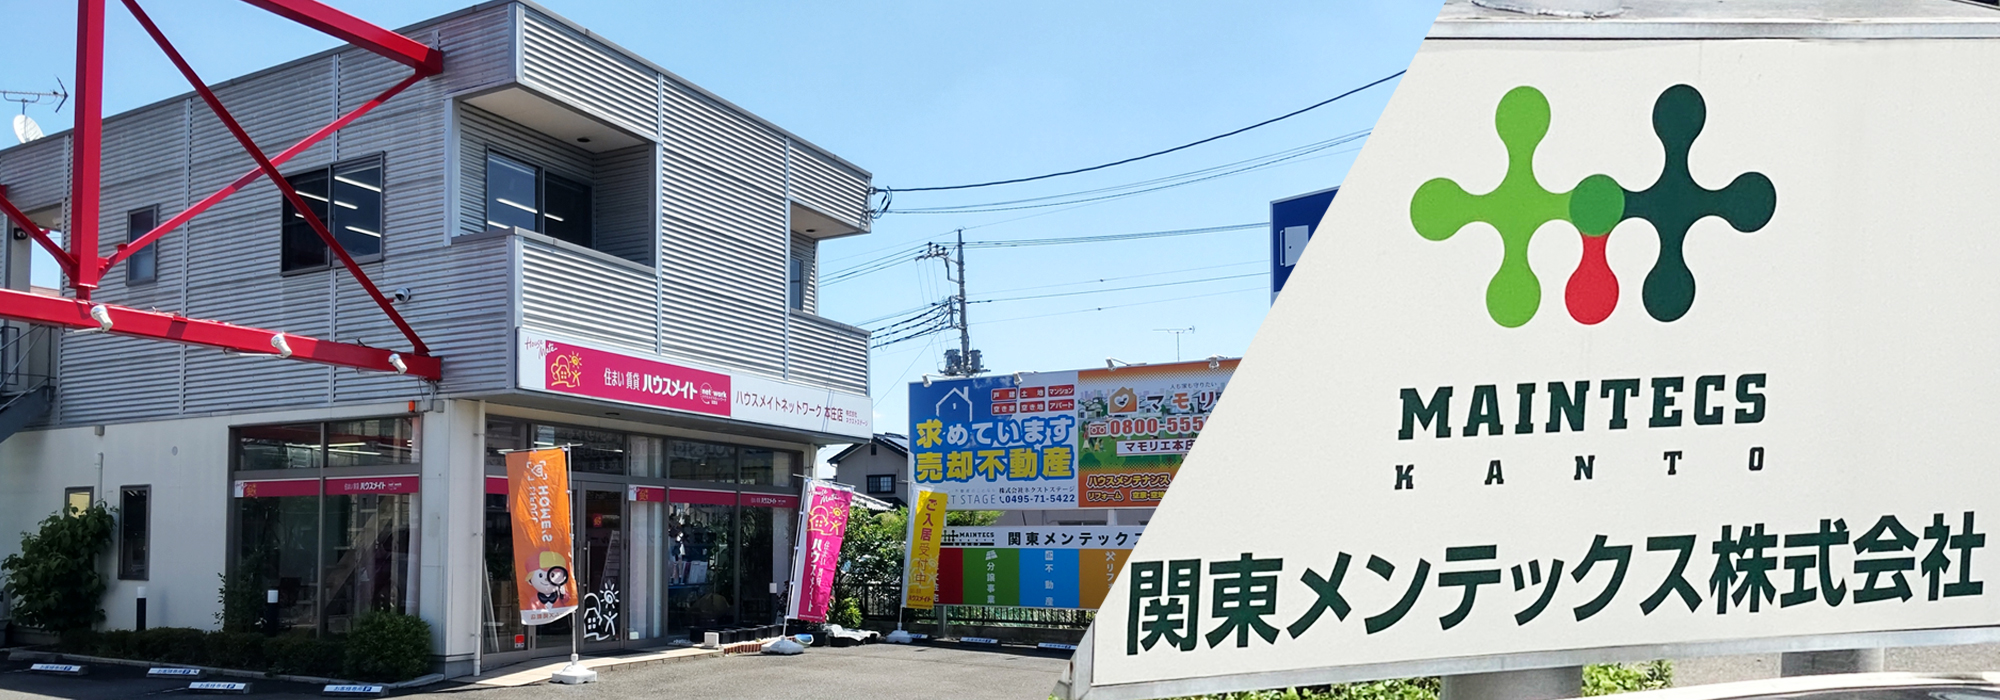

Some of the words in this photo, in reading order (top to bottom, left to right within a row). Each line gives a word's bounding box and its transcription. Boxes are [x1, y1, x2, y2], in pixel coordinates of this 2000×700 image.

[525, 336, 544, 350] House
[538, 343, 558, 360] Mate
[604, 367, 625, 387] 住まい
[626, 371, 640, 391] 賃貸
[642, 373, 698, 400] ハウスメイト
[1049, 387, 1074, 395] マンション
[735, 390, 822, 418] ハウスメイトネットワーク
[824, 406, 844, 422] 本庄店
[1049, 402, 1073, 410] アパート
[1147, 391, 1220, 410] マモリ
[1398, 373, 1767, 441] MAINTECS
[916, 417, 1073, 449] 求めています
[1110, 416, 1210, 435] 0800-555
[916, 446, 1073, 482] 売却不動産
[1394, 446, 1765, 491] KANTO
[999, 486, 1075, 495] 株式会社ネクストステージ
[1088, 474, 1171, 487] ハウスメンテナンス
[961, 494, 995, 505] STAGE
[1005, 494, 1075, 504] 0495-71-5422
[1087, 491, 1123, 500] リフォーム
[916, 499, 938, 587] ご入居受付中
[808, 538, 822, 613] ハウスメイト
[1045, 563, 1054, 607] 不動産
[1126, 510, 1986, 656] 関東メンテックス株式会社
